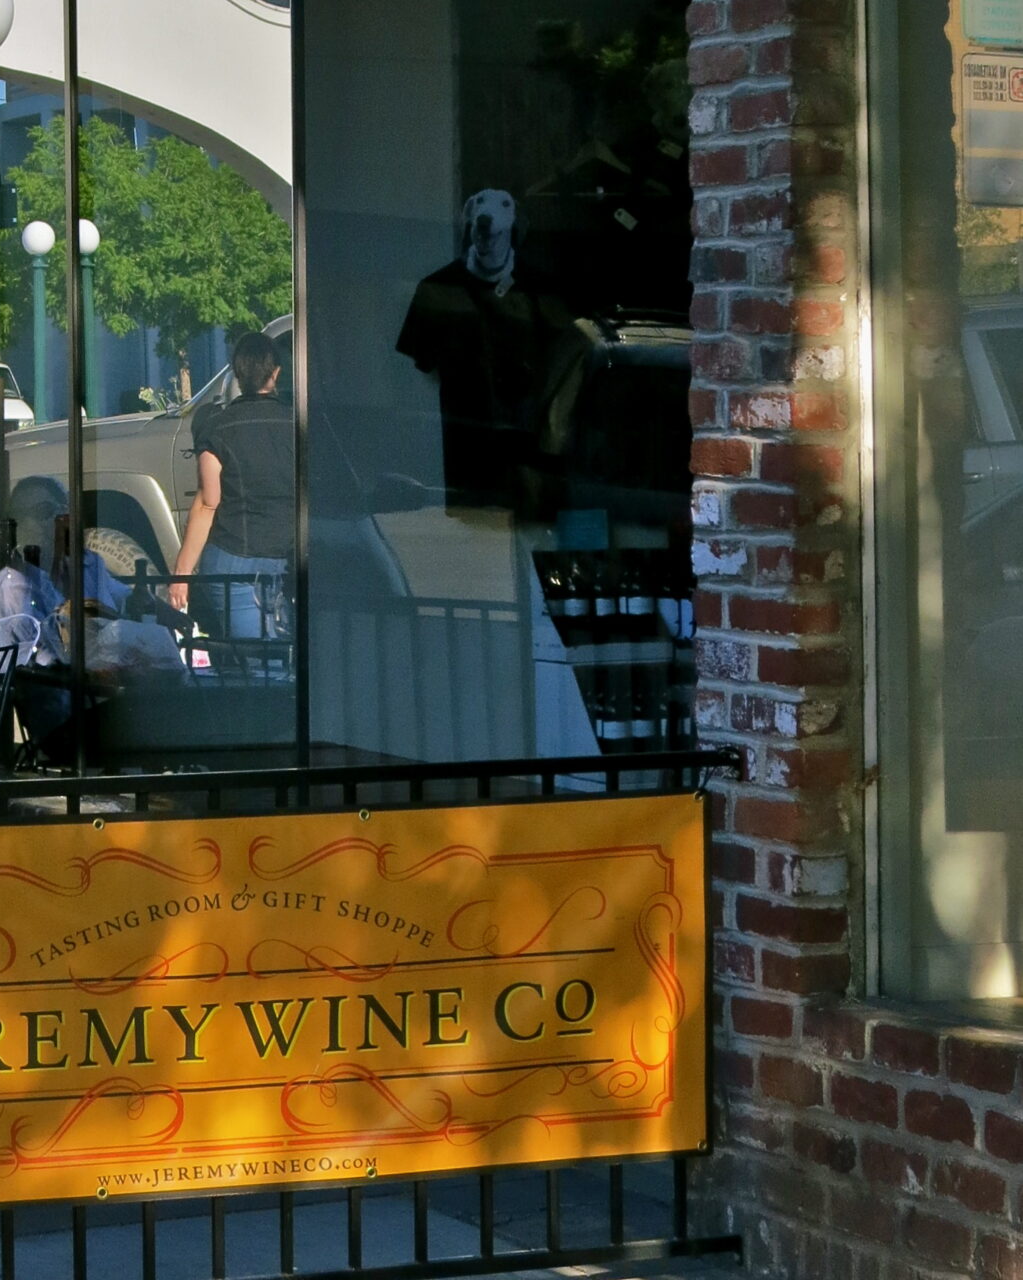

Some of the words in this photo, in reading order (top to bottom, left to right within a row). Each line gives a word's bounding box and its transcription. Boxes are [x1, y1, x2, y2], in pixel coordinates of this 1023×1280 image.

[30, 910, 141, 968] TASTING
[147, 892, 222, 922] ROOM
[231, 884, 256, 911] &
[263, 891, 326, 913] GIFT
[337, 900, 437, 948] SHOPPE
[234, 986, 469, 1059] WINE
